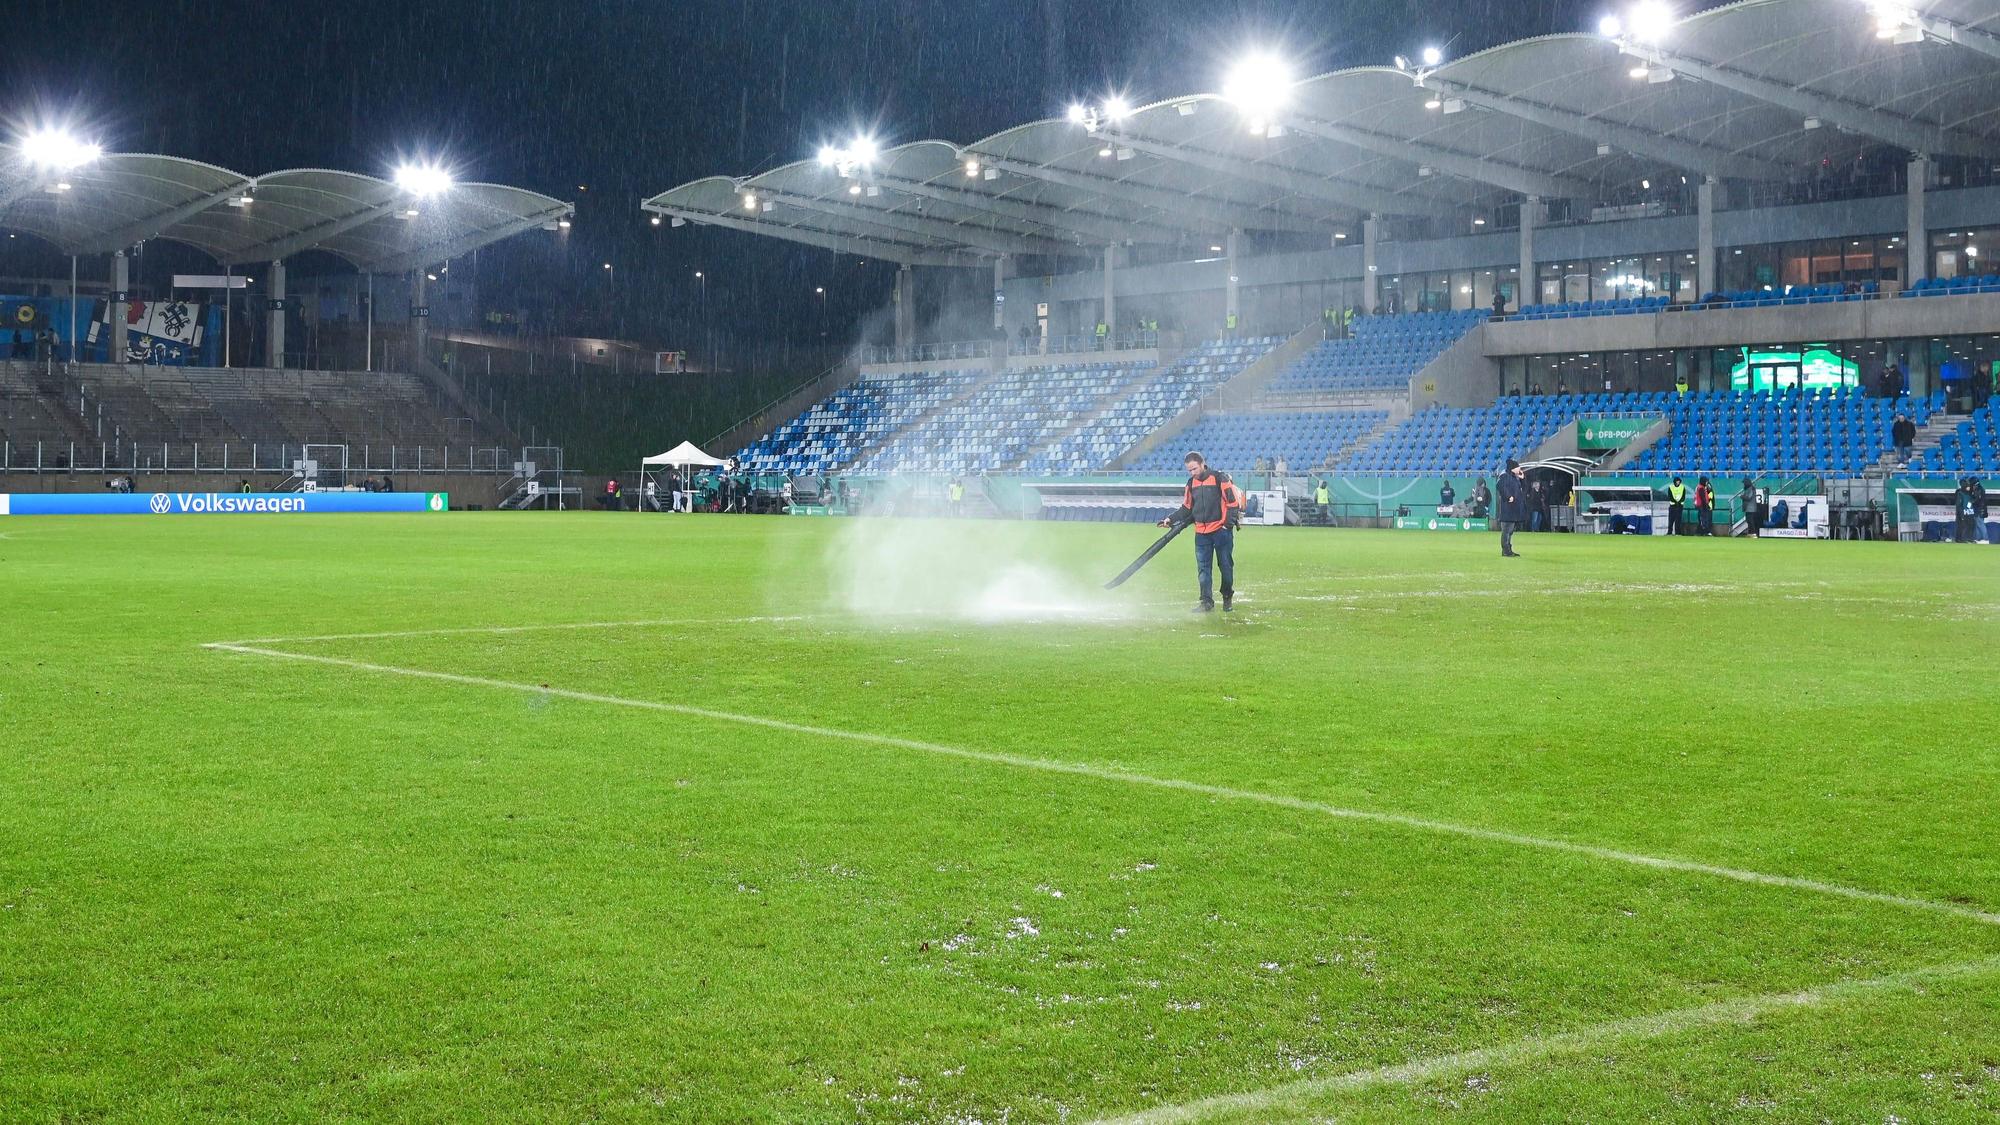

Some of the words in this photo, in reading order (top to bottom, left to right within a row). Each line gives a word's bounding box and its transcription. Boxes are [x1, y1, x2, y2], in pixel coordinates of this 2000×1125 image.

[119, 293, 125, 301] 8
[305, 484, 315, 492] E4
[177, 493, 305, 513] Volkswagen
